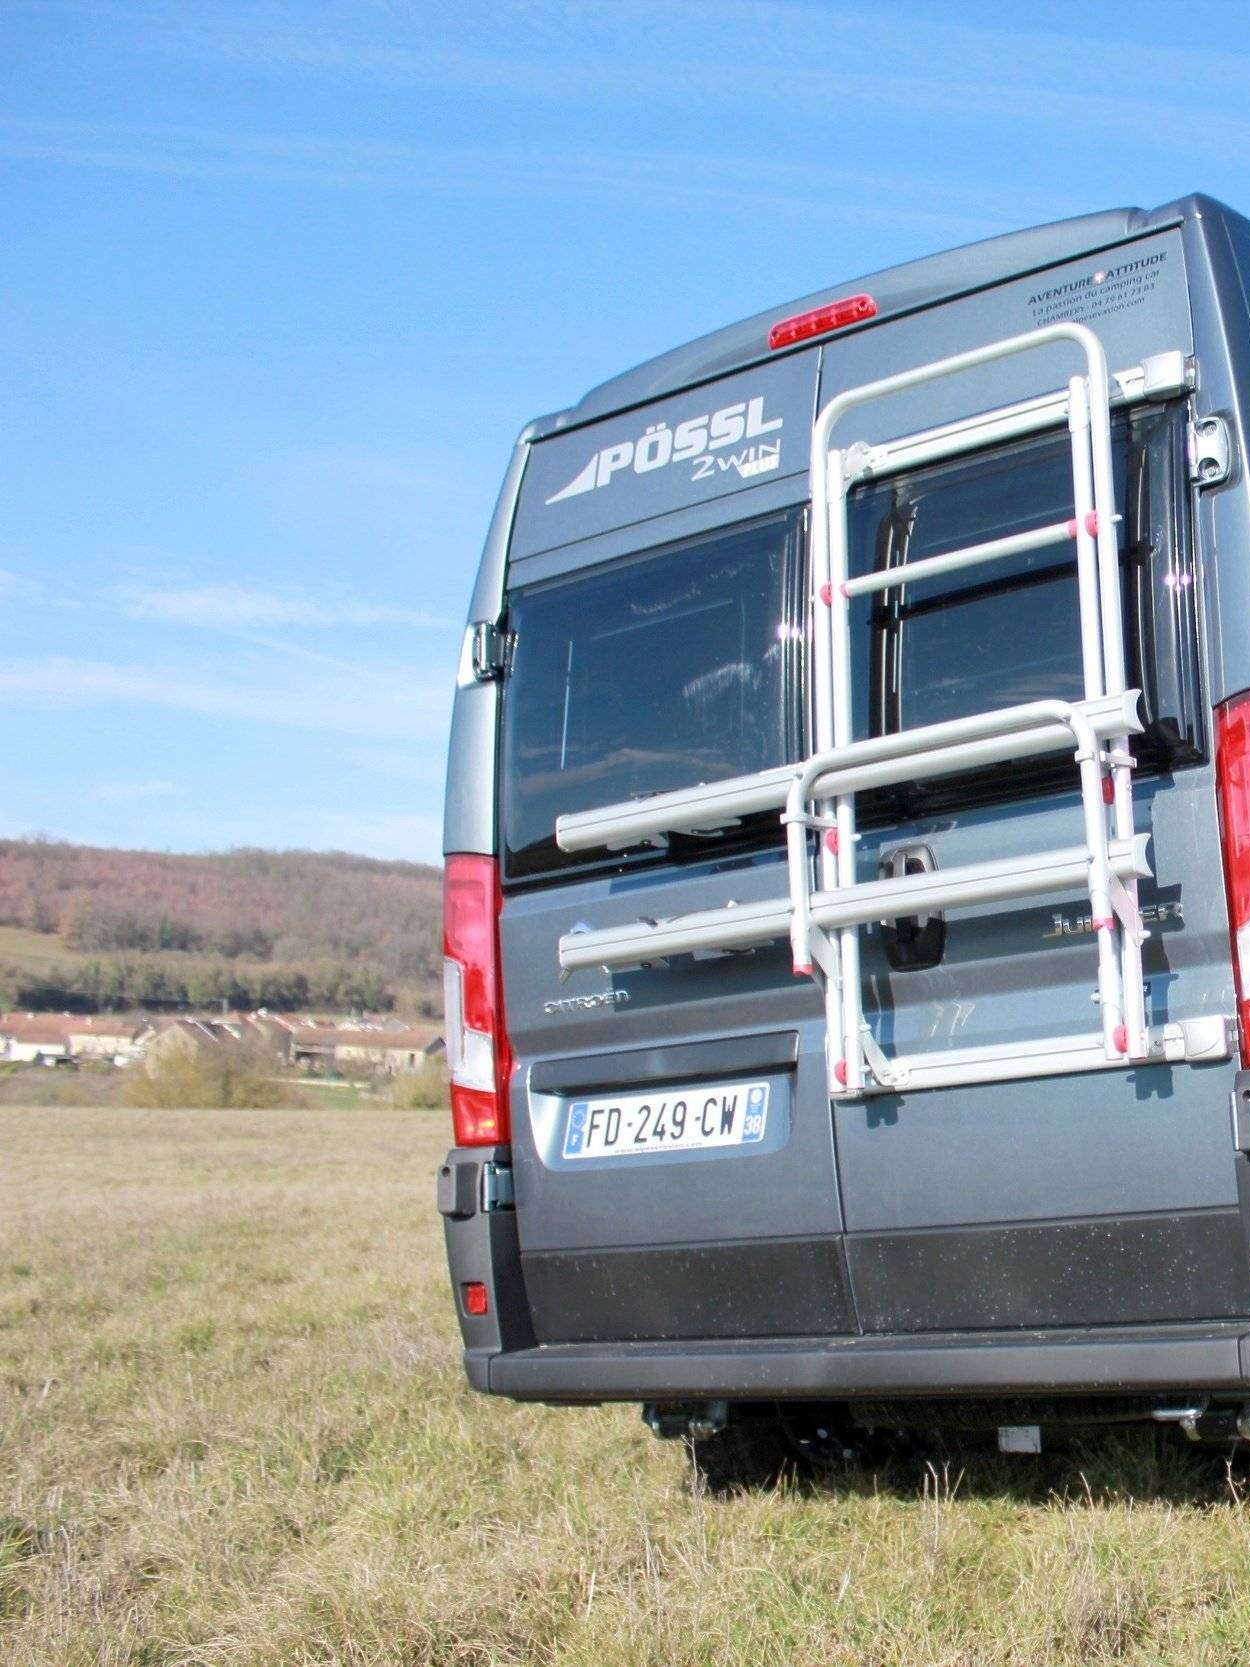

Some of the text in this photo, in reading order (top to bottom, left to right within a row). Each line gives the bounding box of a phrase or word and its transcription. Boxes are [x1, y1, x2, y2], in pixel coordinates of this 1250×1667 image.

[1027, 251, 1168, 306] AVENTURE ATTITUDE
[1046, 295, 1082, 315] passion
[1085, 290, 1098, 300] du
[1100, 275, 1142, 295] camping
[1145, 269, 1160, 280] car
[1037, 306, 1085, 326] CHAMBERY
[596, 397, 783, 487] PÖSSL
[571, 1134, 579, 1146] F
[586, 1095, 738, 1148] FD-249-CW
[744, 1115, 762, 1135] 38
